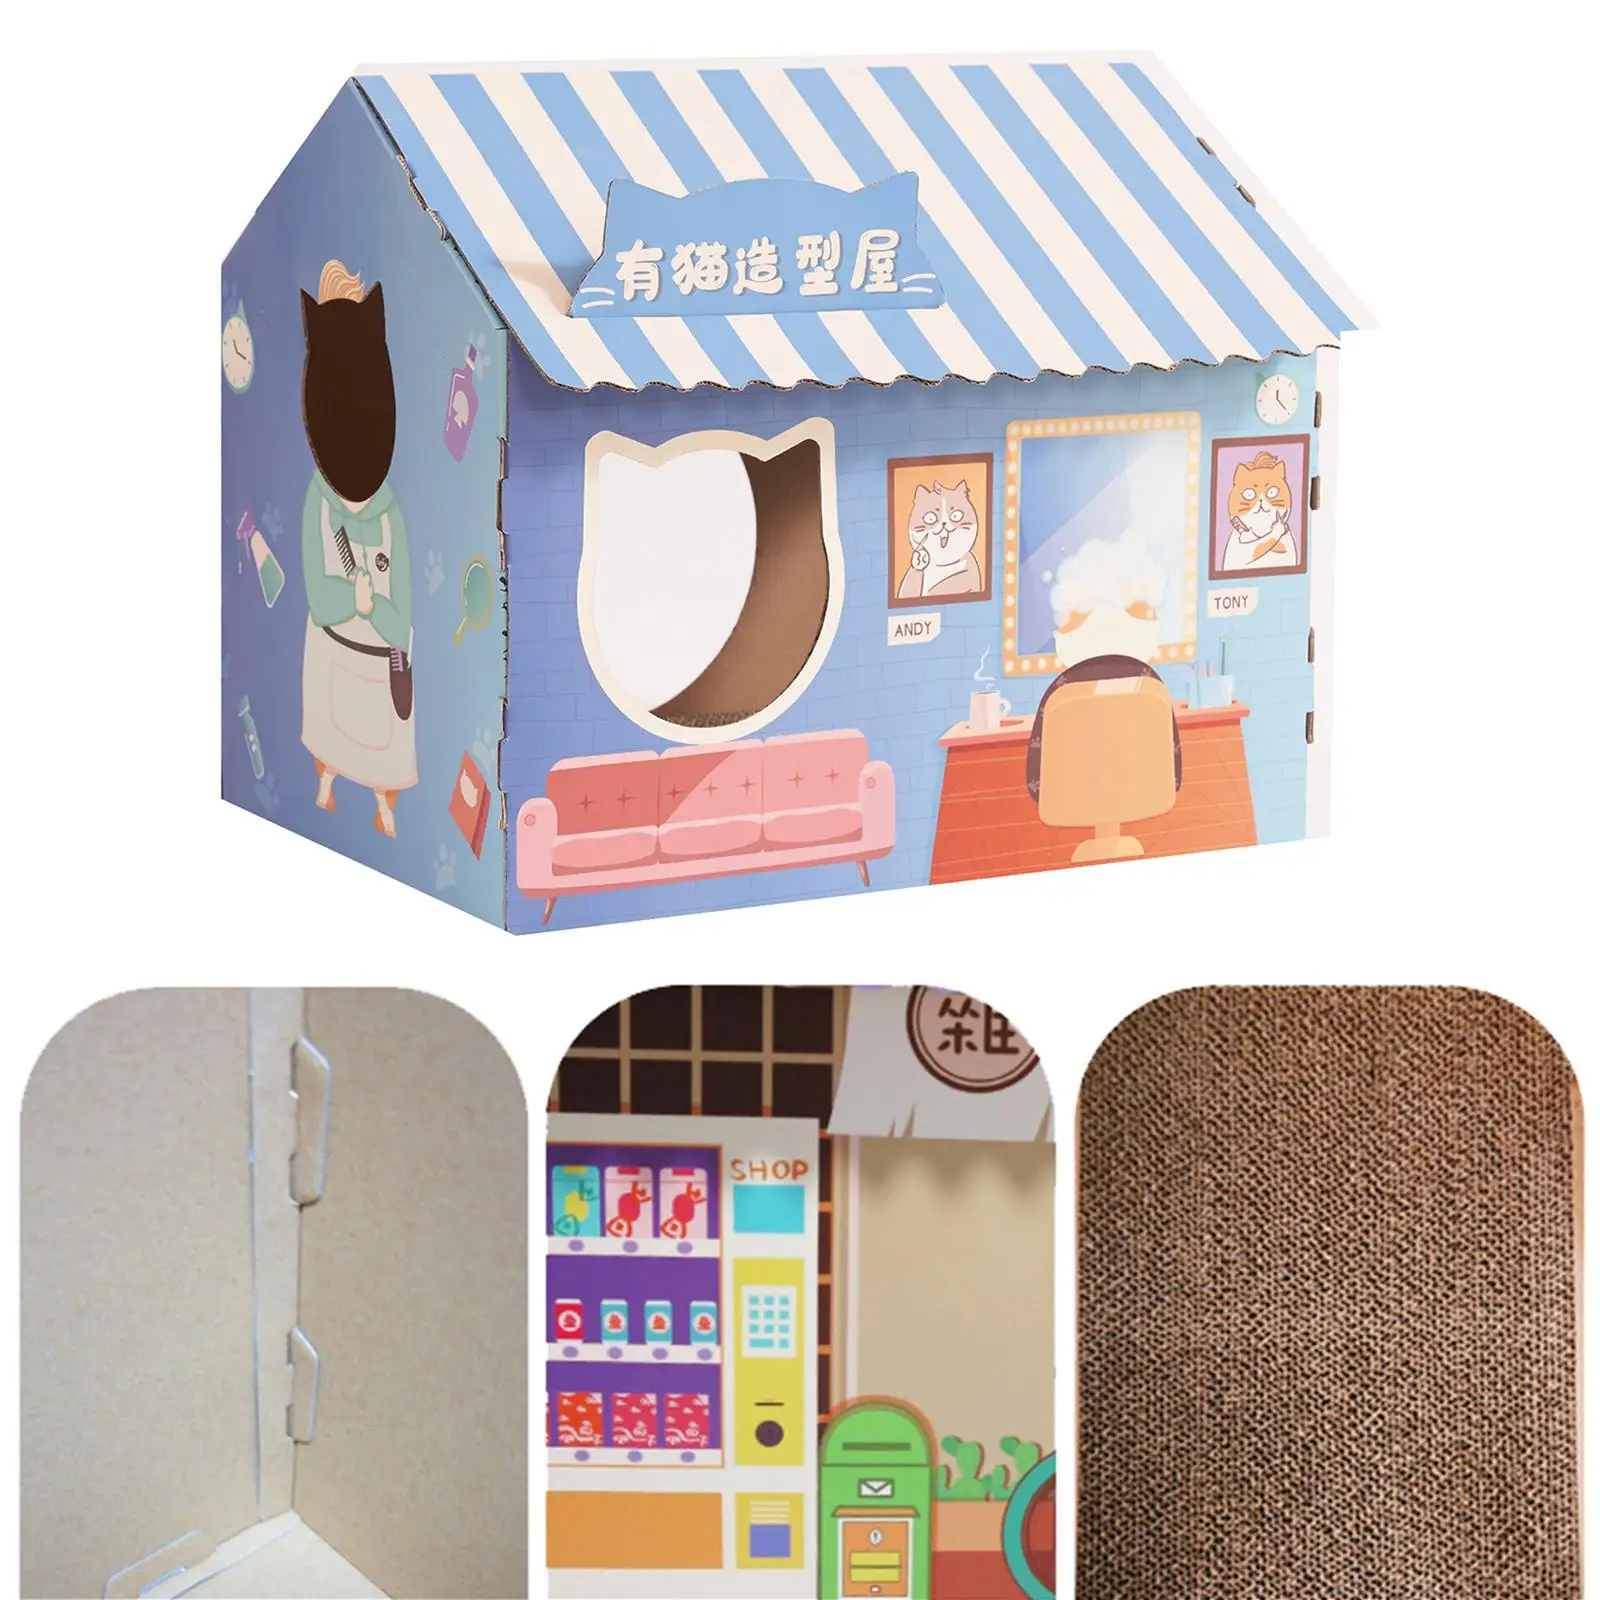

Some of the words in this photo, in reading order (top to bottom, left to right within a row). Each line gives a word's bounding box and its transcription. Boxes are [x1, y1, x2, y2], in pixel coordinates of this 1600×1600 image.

[615, 228, 901, 302] 有猫造型屋
[1214, 595, 1249, 610] TONY
[894, 620, 932, 637] ANDY
[730, 1158, 809, 1182] SHOP
